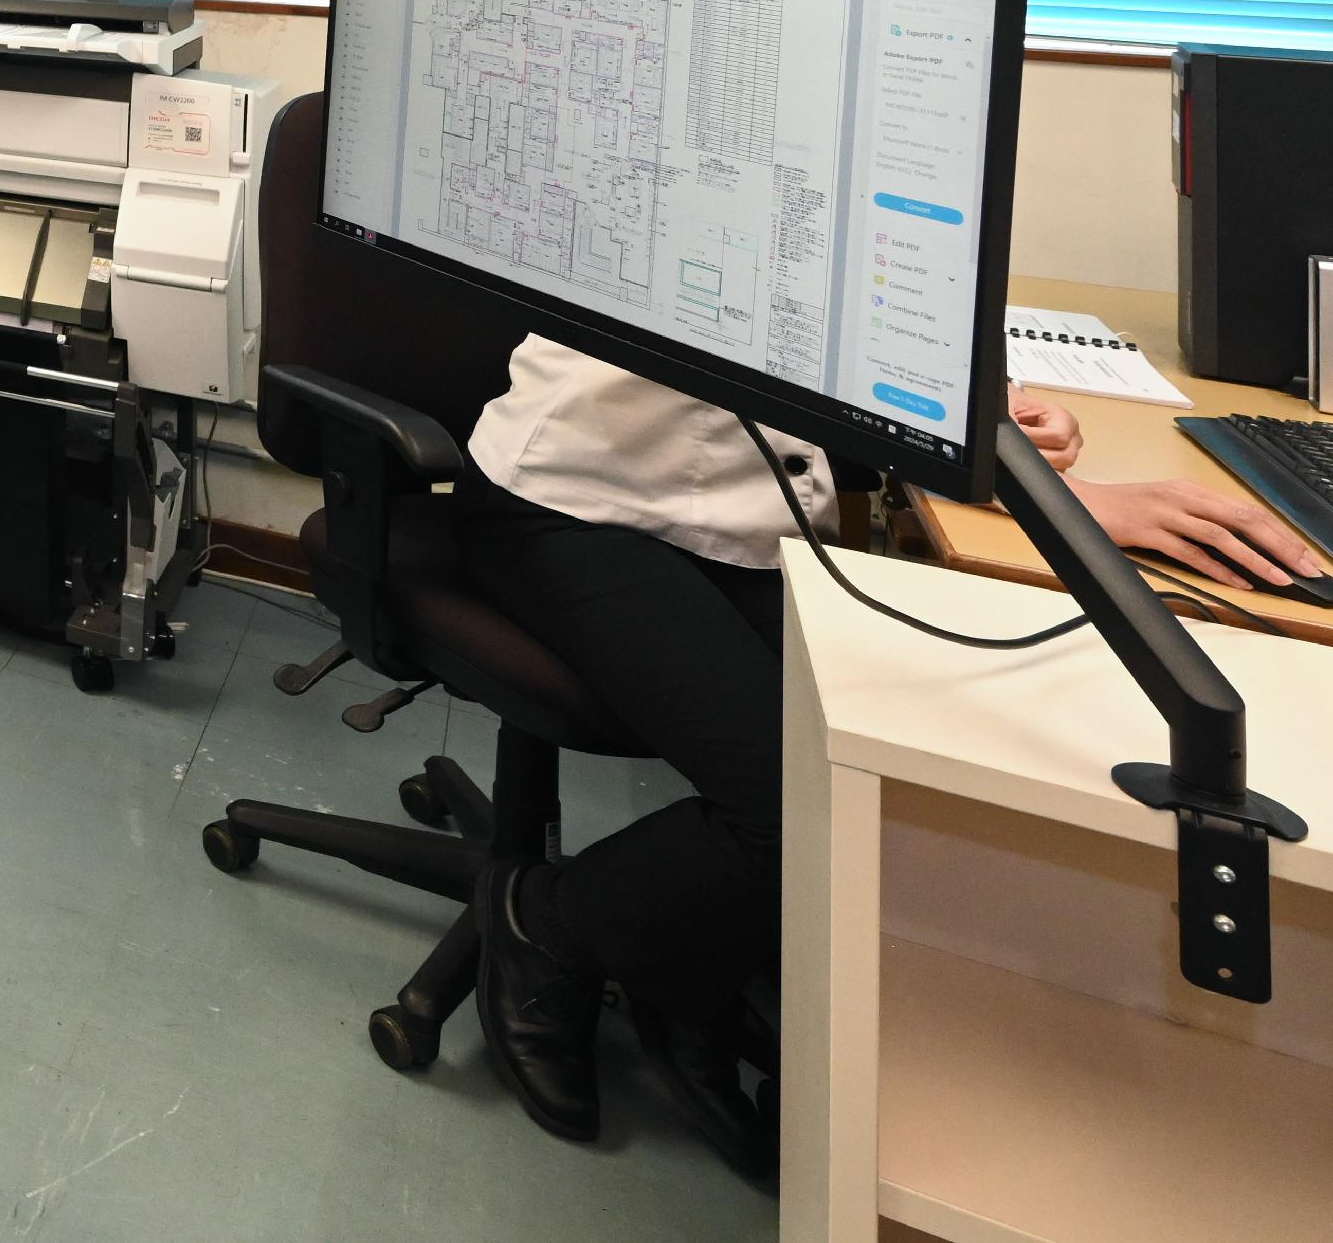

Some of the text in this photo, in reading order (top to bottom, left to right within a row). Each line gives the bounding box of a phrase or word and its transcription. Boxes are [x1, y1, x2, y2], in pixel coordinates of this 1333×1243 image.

[906, 29, 943, 40] Export PDF
[906, 54, 927, 62] Export
[904, 202, 931, 214] Convert
[892, 239, 920, 252] Edit PDF
[890, 260, 928, 276] Create PDF
[889, 281, 923, 296] Comment
[888, 302, 936, 323] Combine Files
[886, 323, 940, 345] Organize Pages
